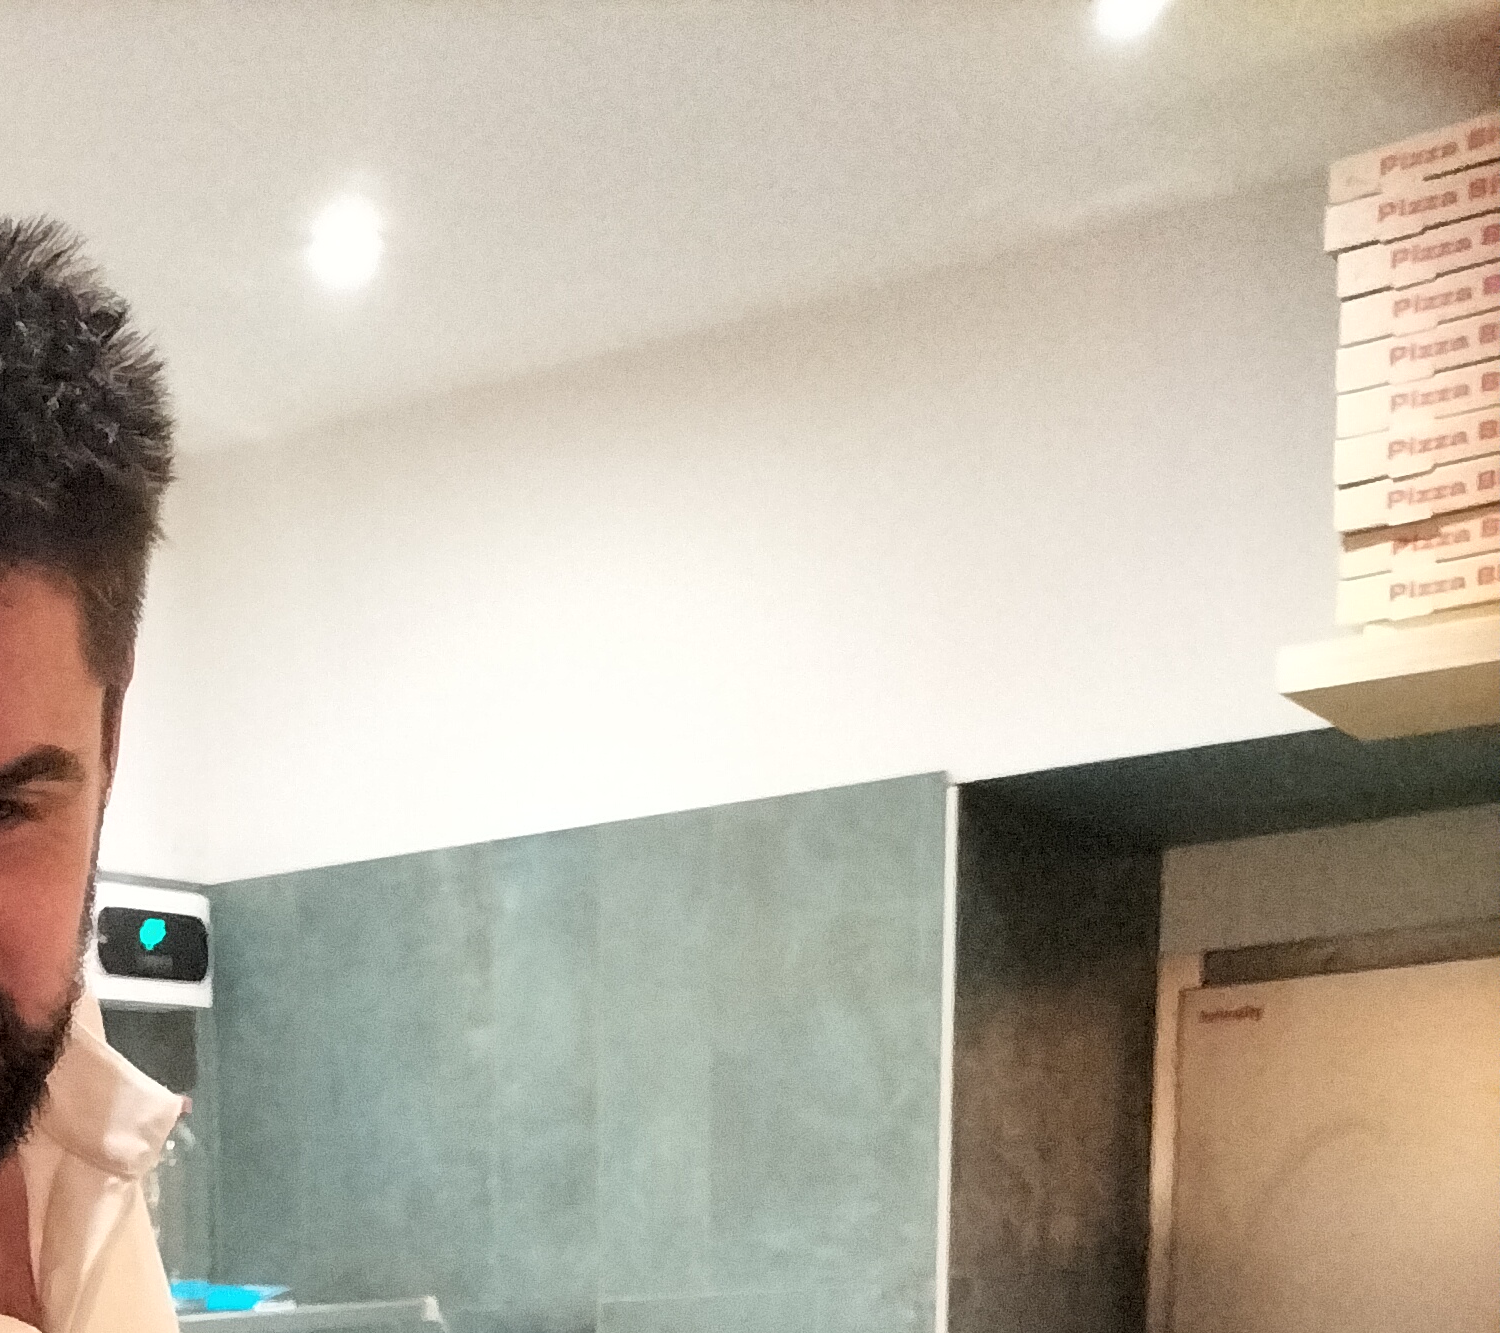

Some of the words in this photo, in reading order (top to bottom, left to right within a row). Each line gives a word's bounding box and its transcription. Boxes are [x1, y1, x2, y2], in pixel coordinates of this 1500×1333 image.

[1378, 190, 1457, 222] Pizza
[1393, 287, 1472, 318] Pizza
[1389, 335, 1470, 366] Pizza
[1390, 384, 1470, 413] Pizza
[1388, 431, 1467, 460] Pizza
[1387, 481, 1466, 509] Pizza
[1389, 576, 1466, 601] Pizza
